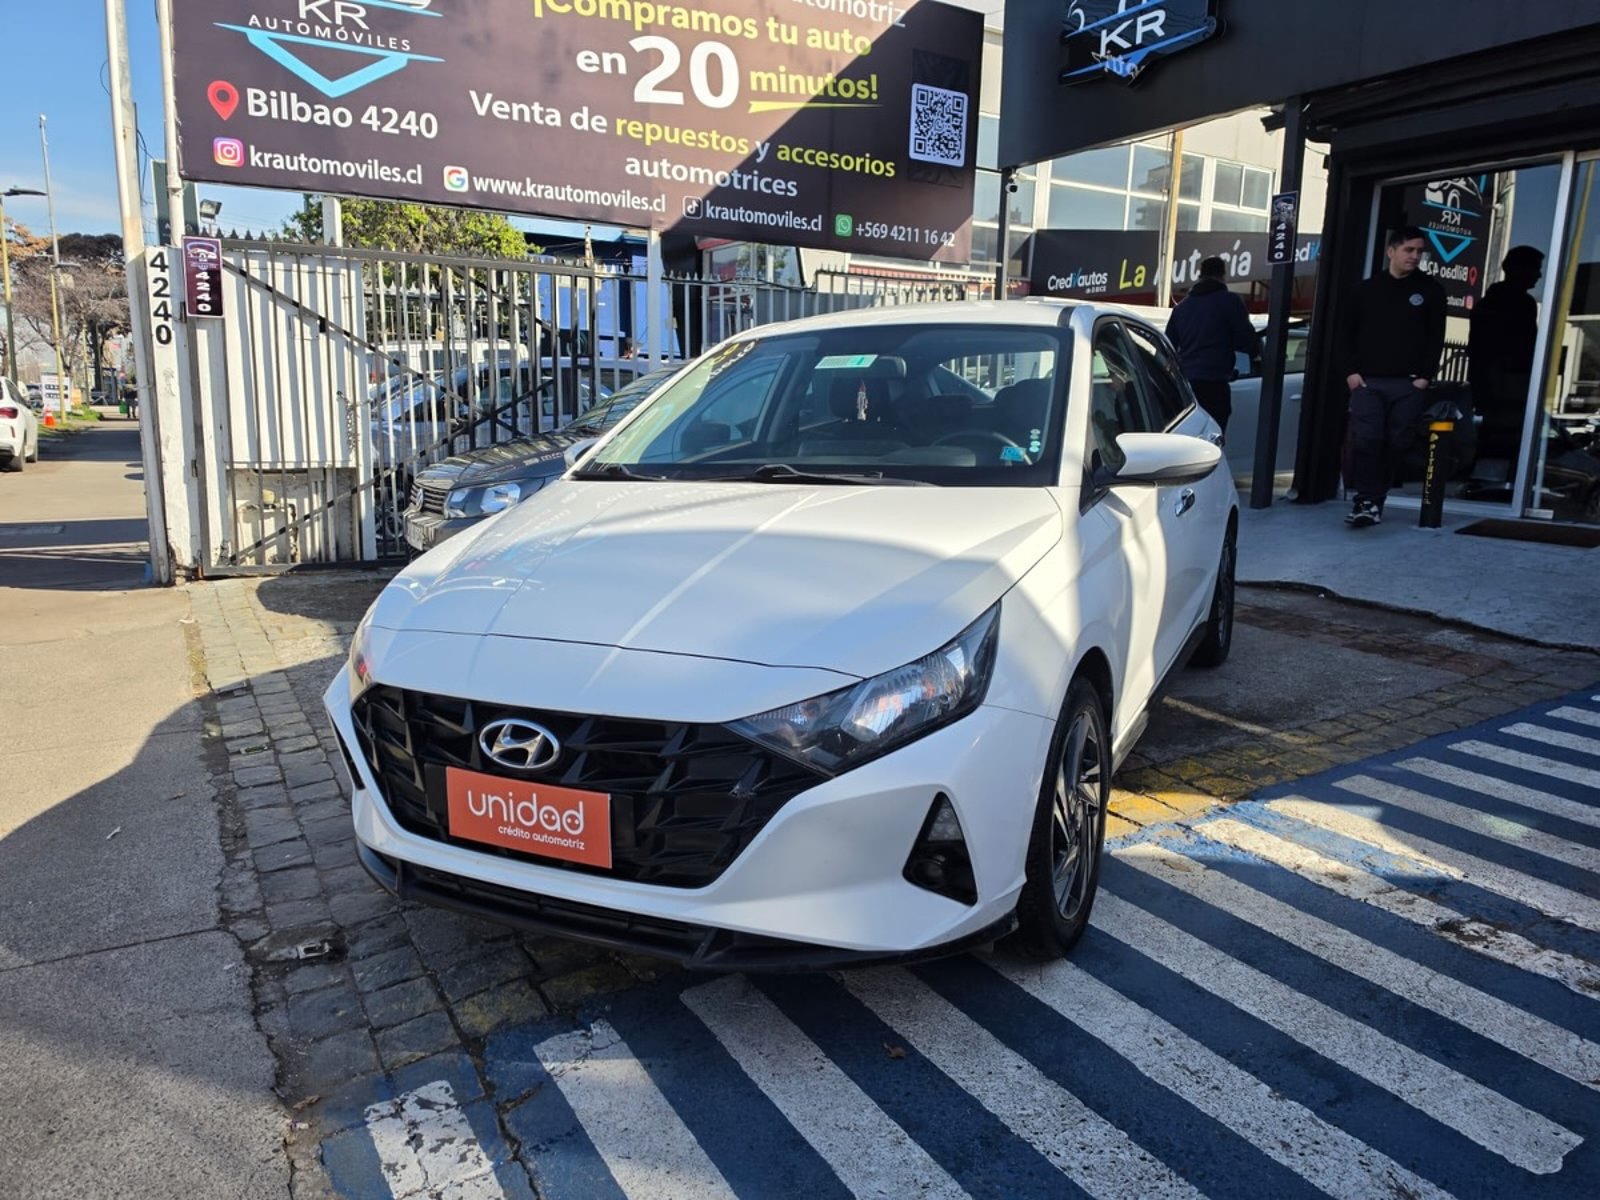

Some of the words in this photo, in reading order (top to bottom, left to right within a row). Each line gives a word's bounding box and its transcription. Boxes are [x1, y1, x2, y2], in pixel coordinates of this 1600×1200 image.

[249, 14, 411, 51] AUTOMÓVILES
[299, 0, 369, 30] KR
[1100, 9, 1166, 57] KR
[766, 16, 798, 45] tu
[806, 28, 872, 56] auto
[576, 50, 627, 74] en
[629, 35, 740, 109] 20
[750, 65, 878, 100] minutos!
[246, 88, 353, 128] Bilbao
[360, 105, 438, 139] 4240
[469, 90, 561, 127] Venta
[570, 106, 607, 133] de
[616, 118, 749, 155] repuestos
[755, 140, 770, 163] y
[777, 144, 896, 177] accesorios
[250, 145, 423, 185] krautomoviles.cl
[625, 156, 798, 197] automotrices
[472, 175, 667, 213] www.krautomoviles.cl
[706, 201, 822, 232] krautomoviles.cl
[856, 221, 888, 239] +569
[890, 225, 920, 243] 4211
[924, 229, 938, 245] 16
[940, 231, 955, 247] 42
[1274, 222, 1286, 260] 4240
[195, 271, 212, 312] 4240
[1119, 258, 1145, 290] La
[149, 251, 172, 345] 4240
[468, 789, 584, 836] unidad
[498, 825, 530, 840] crédito
[532, 831, 585, 850] automotriz
